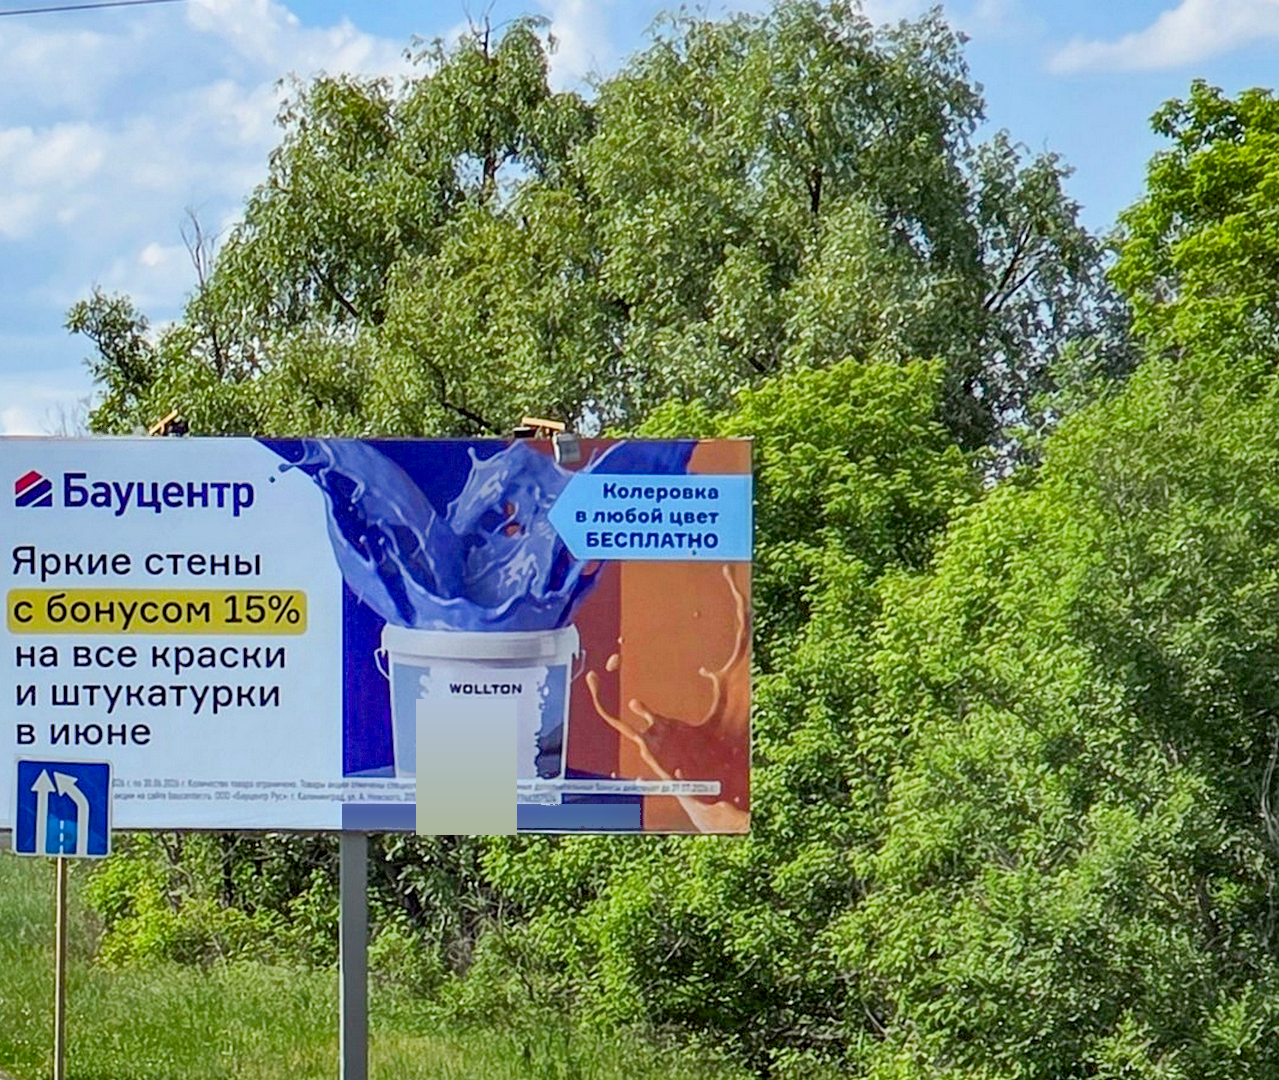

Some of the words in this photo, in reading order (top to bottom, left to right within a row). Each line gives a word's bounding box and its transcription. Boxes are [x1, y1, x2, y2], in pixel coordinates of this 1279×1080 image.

[63, 472, 255, 517] Бауцентр
[602, 482, 719, 502] Колеровка
[575, 511, 587, 523] в
[592, 508, 663, 524] любой
[669, 511, 719, 526] цвет
[585, 531, 719, 549] БЕСПЛАТНО
[12, 545, 132, 582] Яркие
[144, 553, 262, 576] стены
[13, 601, 34, 623] с
[46, 592, 211, 630] бонусом
[223, 595, 301, 625] 15%
[15, 645, 59, 668] на
[72, 645, 138, 668] все
[151, 645, 287, 675] краски
[15, 684, 37, 706] и
[51, 684, 281, 714] штукатурки
[449, 683, 523, 695] WOLLTON
[16, 723, 36, 745] в
[49, 722, 152, 745] июне
